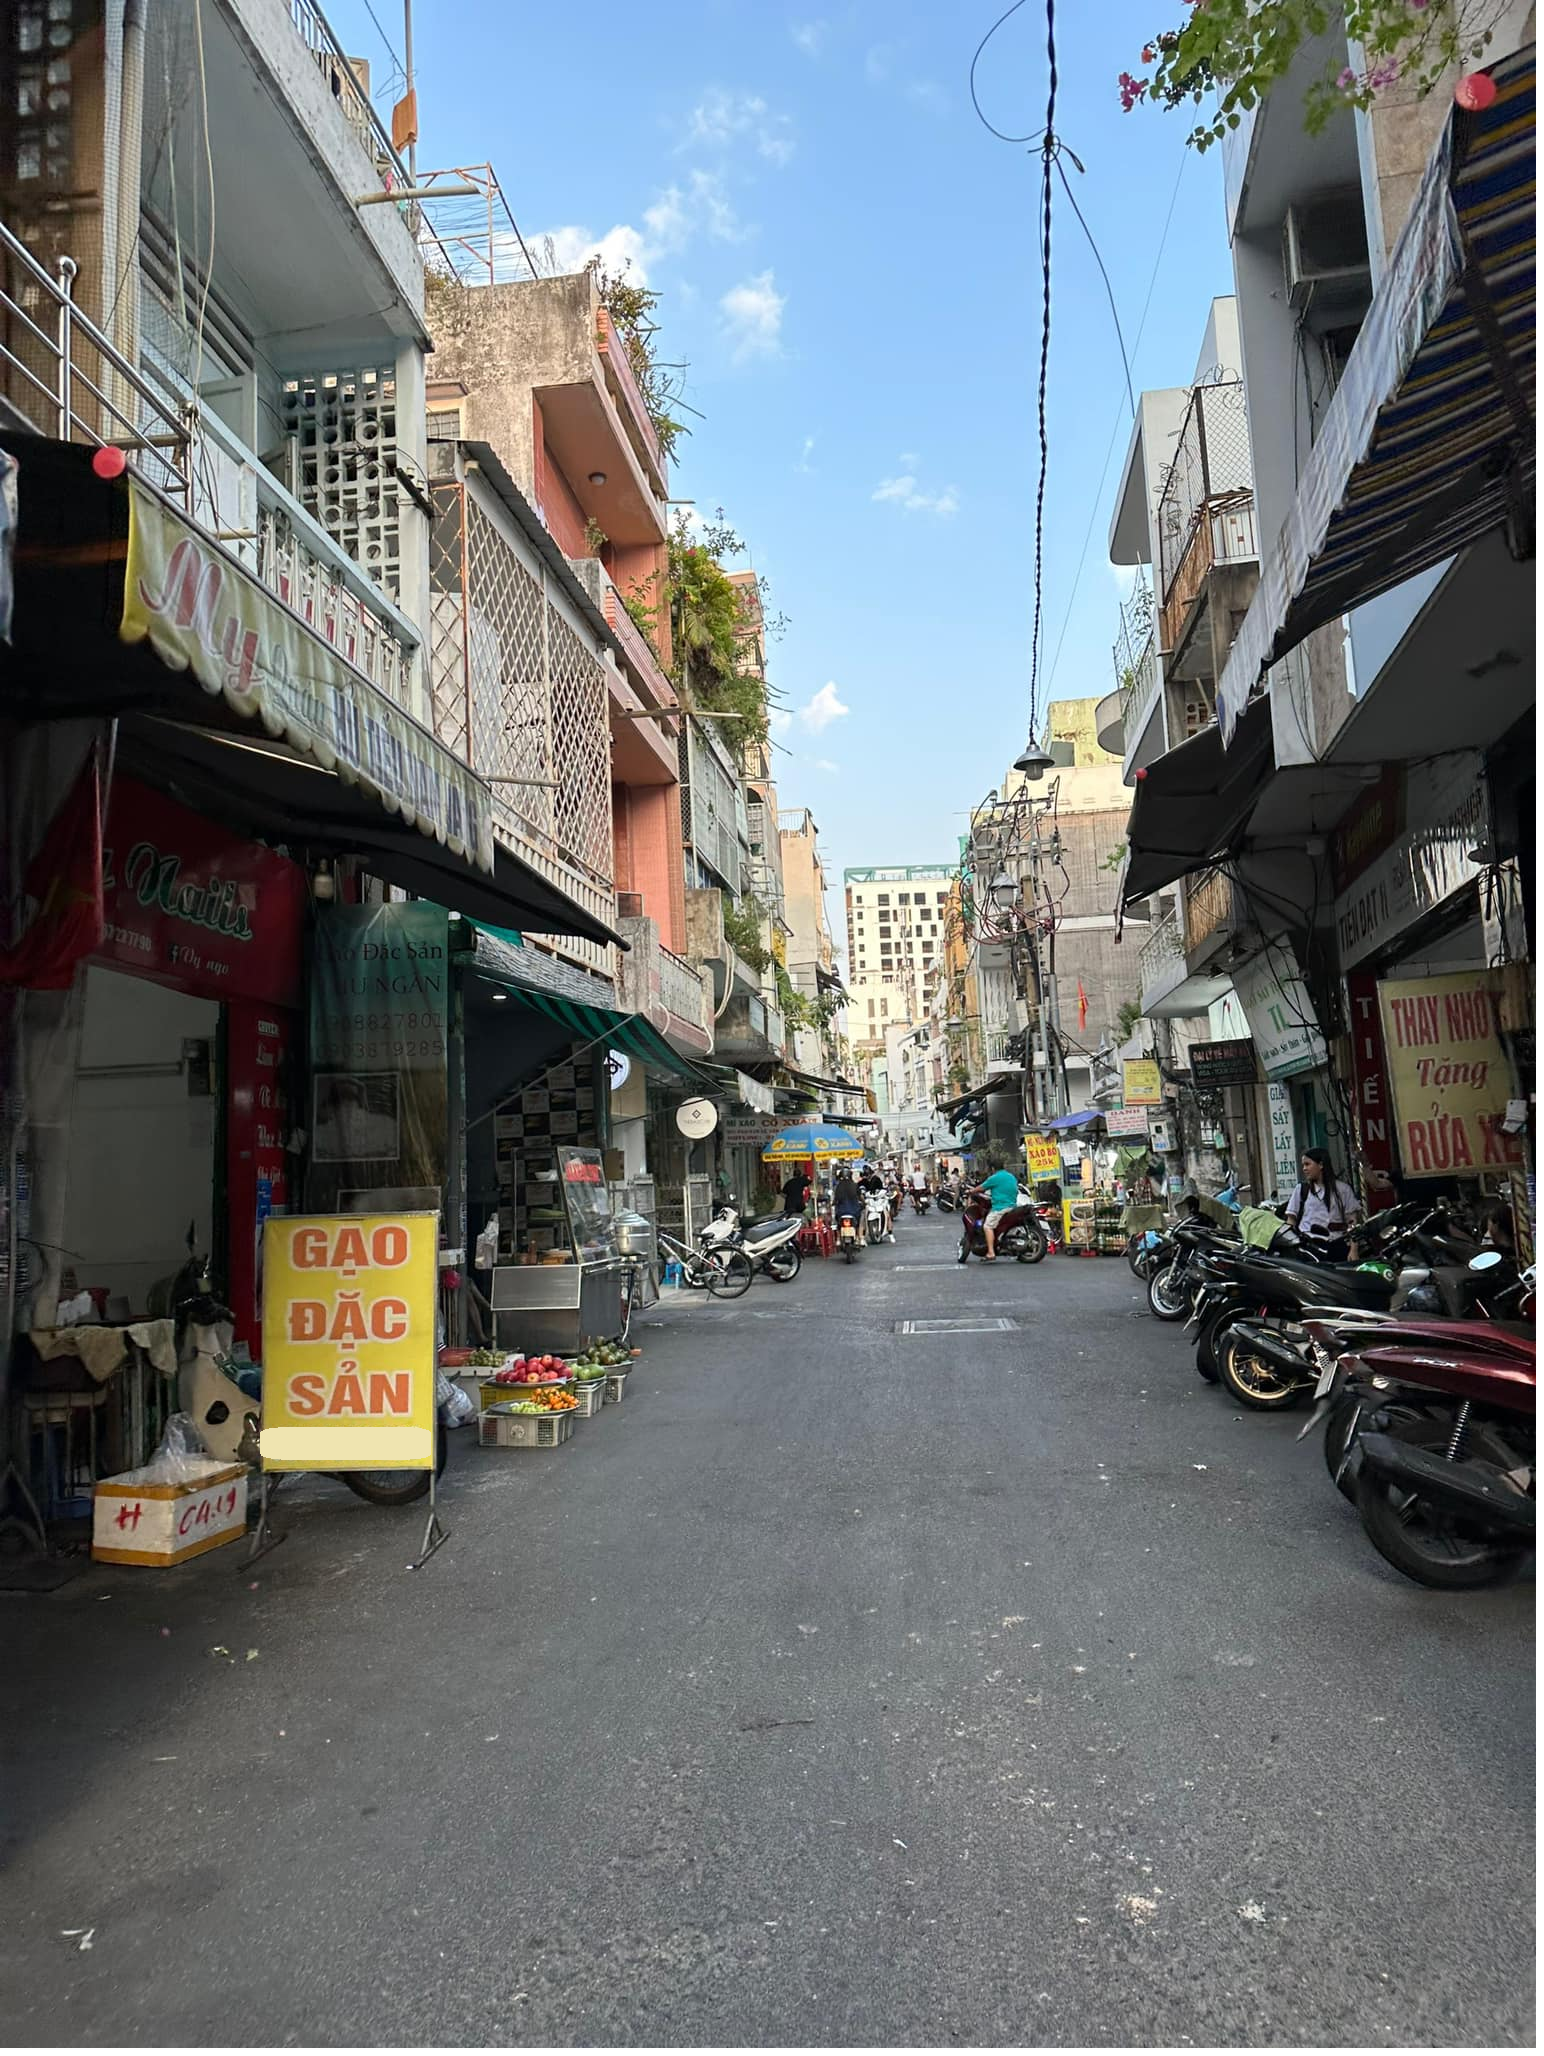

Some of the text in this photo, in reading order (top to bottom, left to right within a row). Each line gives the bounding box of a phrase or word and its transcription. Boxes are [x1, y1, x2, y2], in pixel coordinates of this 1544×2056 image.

[1391, 995, 1440, 1047] THAY
[1417, 1056, 1489, 1093] Tặng
[1407, 1101, 1474, 1171] RỬA
[292, 1225, 408, 1277] GẠO
[288, 1291, 408, 1350] ĐẶC
[288, 1360, 410, 1416] SẢN
[114, 1503, 142, 1531] H
